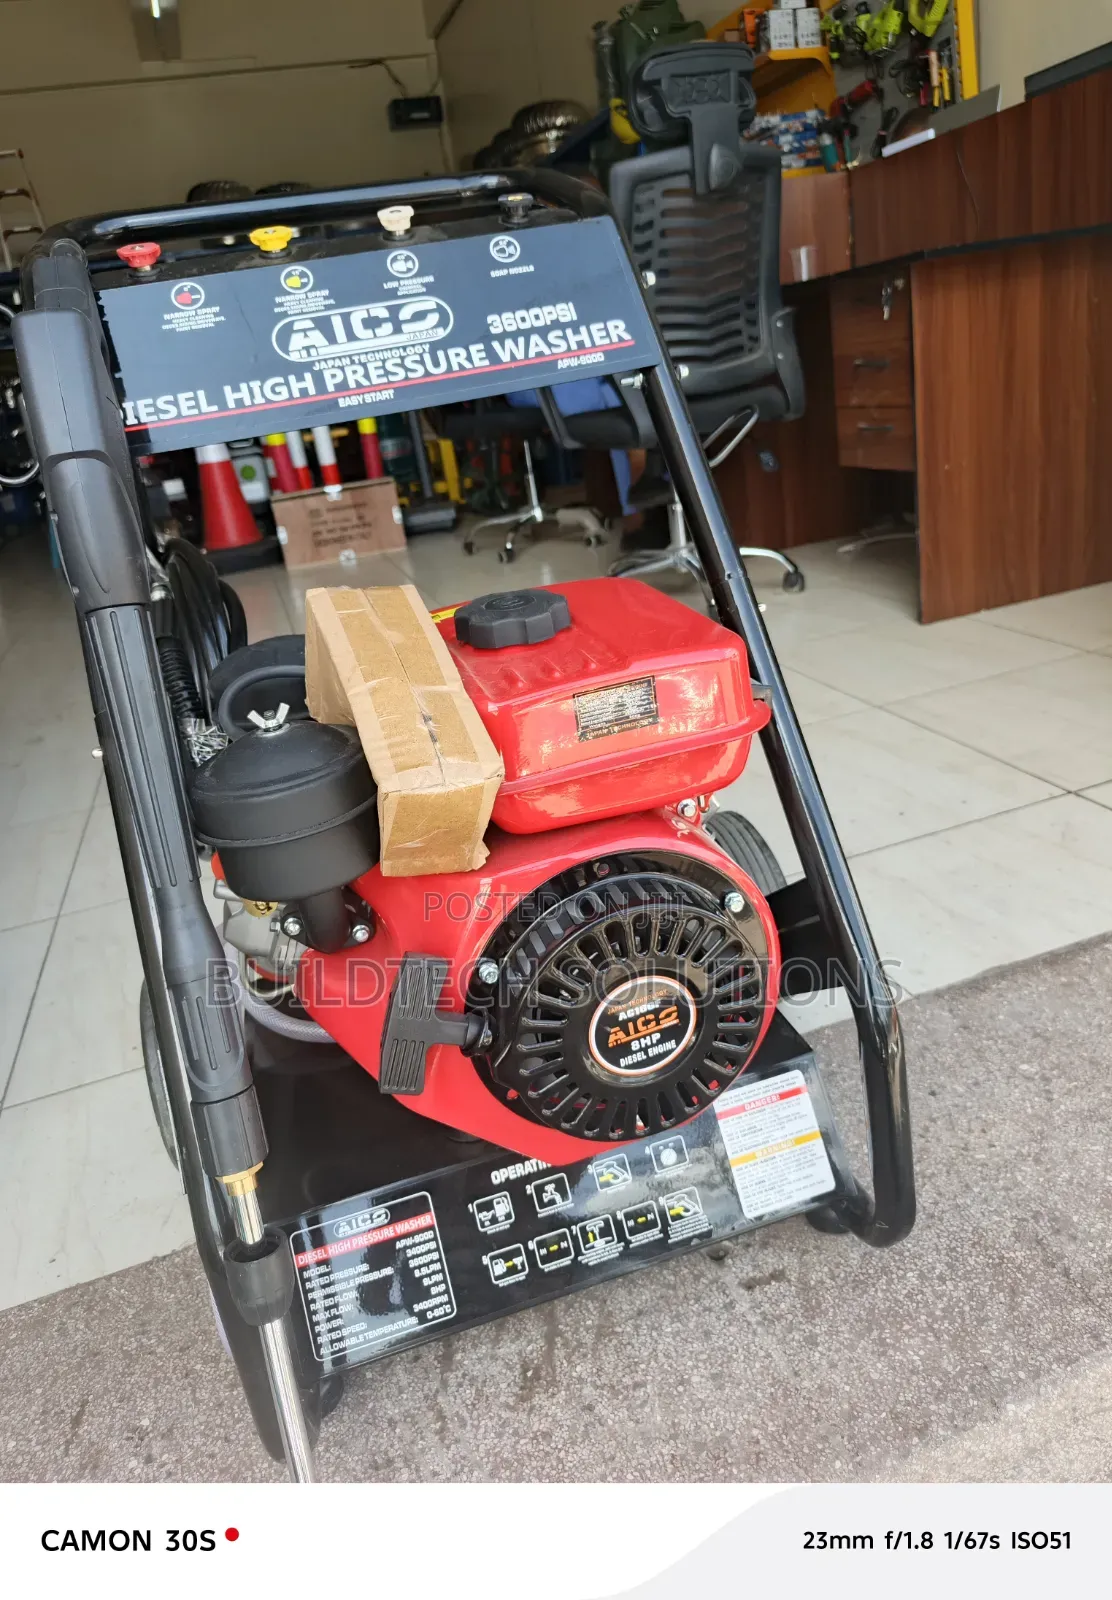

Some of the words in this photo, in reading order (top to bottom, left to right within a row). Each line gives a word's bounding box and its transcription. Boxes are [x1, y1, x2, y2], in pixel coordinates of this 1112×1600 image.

[490, 269, 508, 277] SOAP
[509, 265, 534, 274] NOZZLE
[383, 281, 398, 289] LOW
[400, 275, 434, 286] PRESSURE
[275, 293, 306, 303] NARROW
[306, 289, 329, 298] SPRAY
[164, 310, 196, 320] NARROW
[196, 306, 220, 315] SPRAY
[486, 302, 578, 334] 3600PSI
[406, 329, 438, 341] JAPAN
[312, 356, 350, 370] JAPAN
[353, 344, 430, 364] TECHNOLOGY
[120, 390, 218, 426] IESEL
[223, 372, 316, 408] HIGH
[322, 342, 490, 392] PRESSURE
[491, 319, 632, 362] WASHER
[338, 393, 363, 408] EASY
[364, 389, 394, 404] START
[608, 1003, 627, 1016] JAPAN
[628, 989, 668, 1008] TECHNOLOGY
[630, 1032, 661, 1051] 8HP
[620, 1050, 646, 1068] DIESEL
[648, 1040, 676, 1058] ENGINE
[744, 1094, 780, 1110] DANGER!
[587, 1164, 593, 1174] 3
[526, 1184, 532, 1195] 2
[468, 1203, 473, 1214] 1
[298, 1248, 328, 1264] DIESEL
[328, 1242, 351, 1257] HIGH
[352, 1228, 394, 1250] PRESSURE
[395, 1214, 432, 1234] WASHER
[571, 1225, 578, 1236] 7
[528, 1240, 534, 1250] 6
[306, 1276, 330, 1290] RATED
[330, 1263, 370, 1282] PRESSURE:
[406, 1241, 437, 1258] 3400PSI
[482, 1255, 488, 1266] 5
[303, 1264, 332, 1278] MODEL:
[308, 1279, 356, 1300] PERMISSIBLE
[356, 1266, 394, 1285] PRESSURE:
[408, 1252, 440, 1268] 3600PSI
[310, 1298, 334, 1312] RATED
[334, 1290, 359, 1304] FLOW:
[314, 1318, 344, 1333] POWER:
[430, 1283, 446, 1295] 8HP
[312, 1310, 330, 1322] MAX
[330, 1302, 354, 1316] FLOW:
[317, 1330, 342, 1344] RATED
[342, 1322, 368, 1336] SPEED:
[412, 1294, 448, 1312] 3400RPM
[320, 1334, 364, 1356] ALLOWABLE
[364, 1316, 418, 1340] TEMPERATURE:
